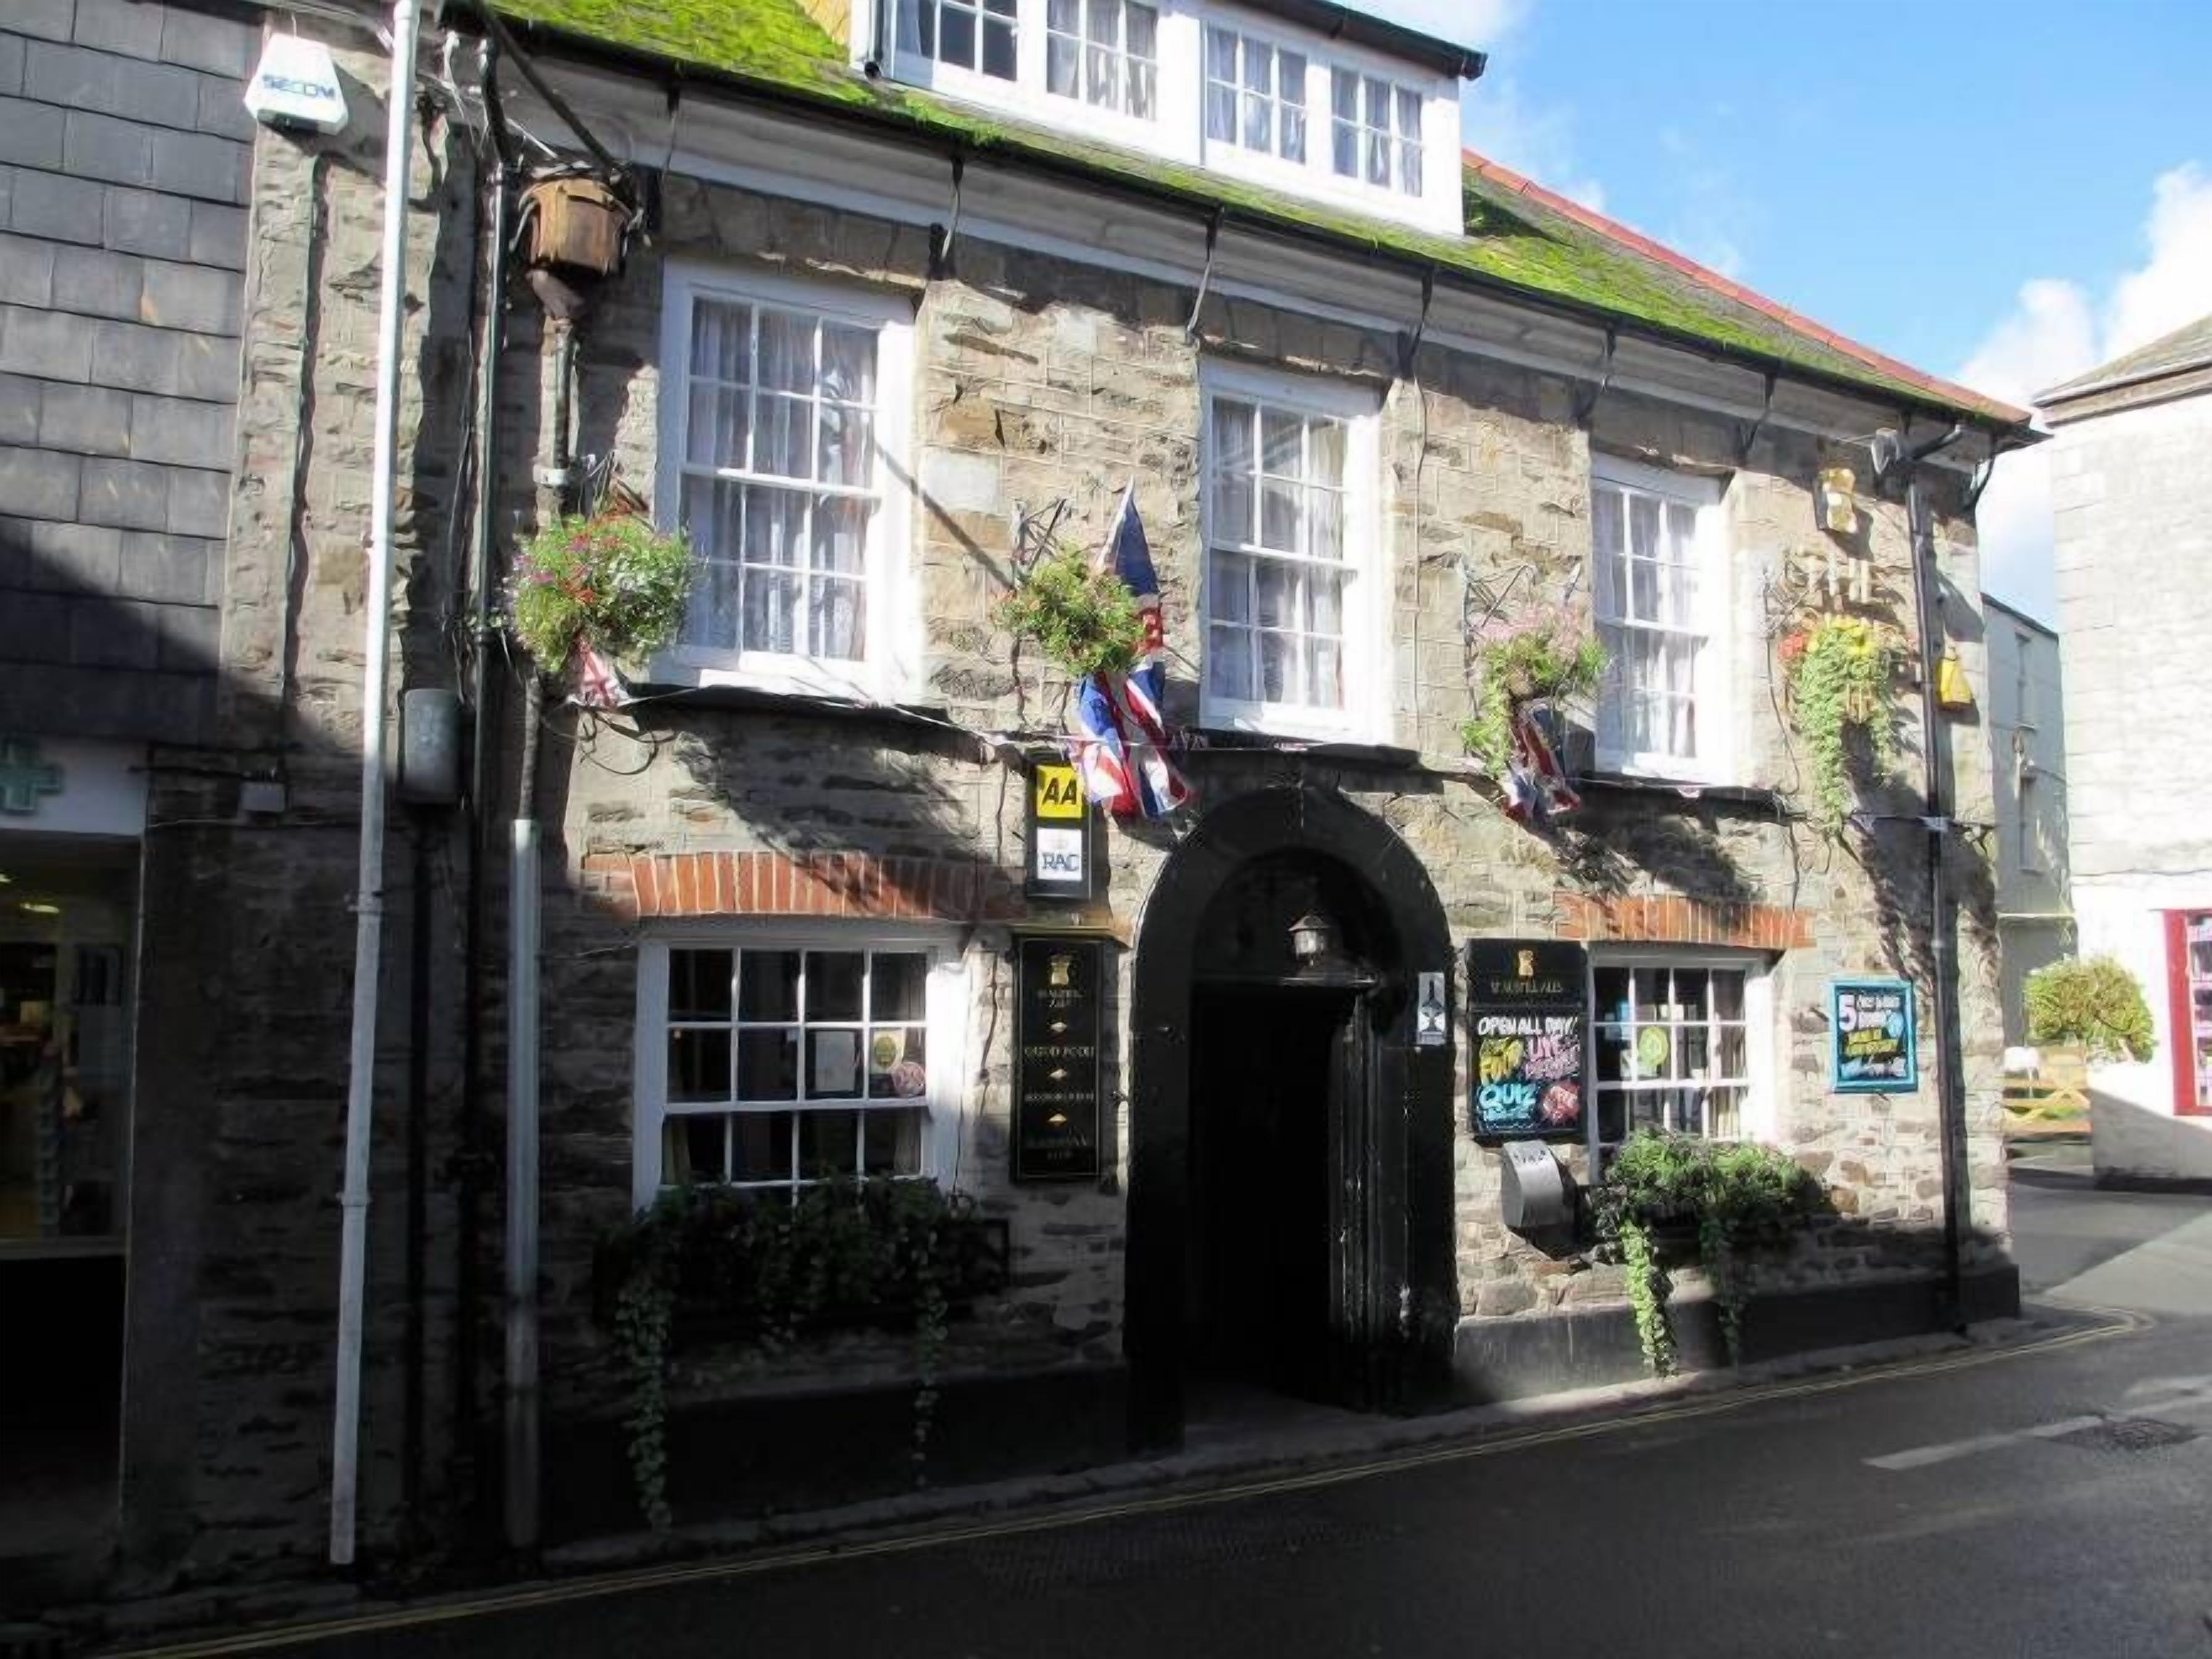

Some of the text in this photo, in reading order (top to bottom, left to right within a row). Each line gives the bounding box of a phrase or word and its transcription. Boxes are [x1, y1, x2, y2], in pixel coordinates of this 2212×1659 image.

[1042, 777, 1078, 805] AA
[1042, 852, 1079, 872] RAC
[1478, 1016, 1516, 1035] OPEN
[1518, 1015, 1542, 1035] ALL
[1839, 995, 1856, 1031] 5
[1479, 1084, 1536, 1109] QUIZ
